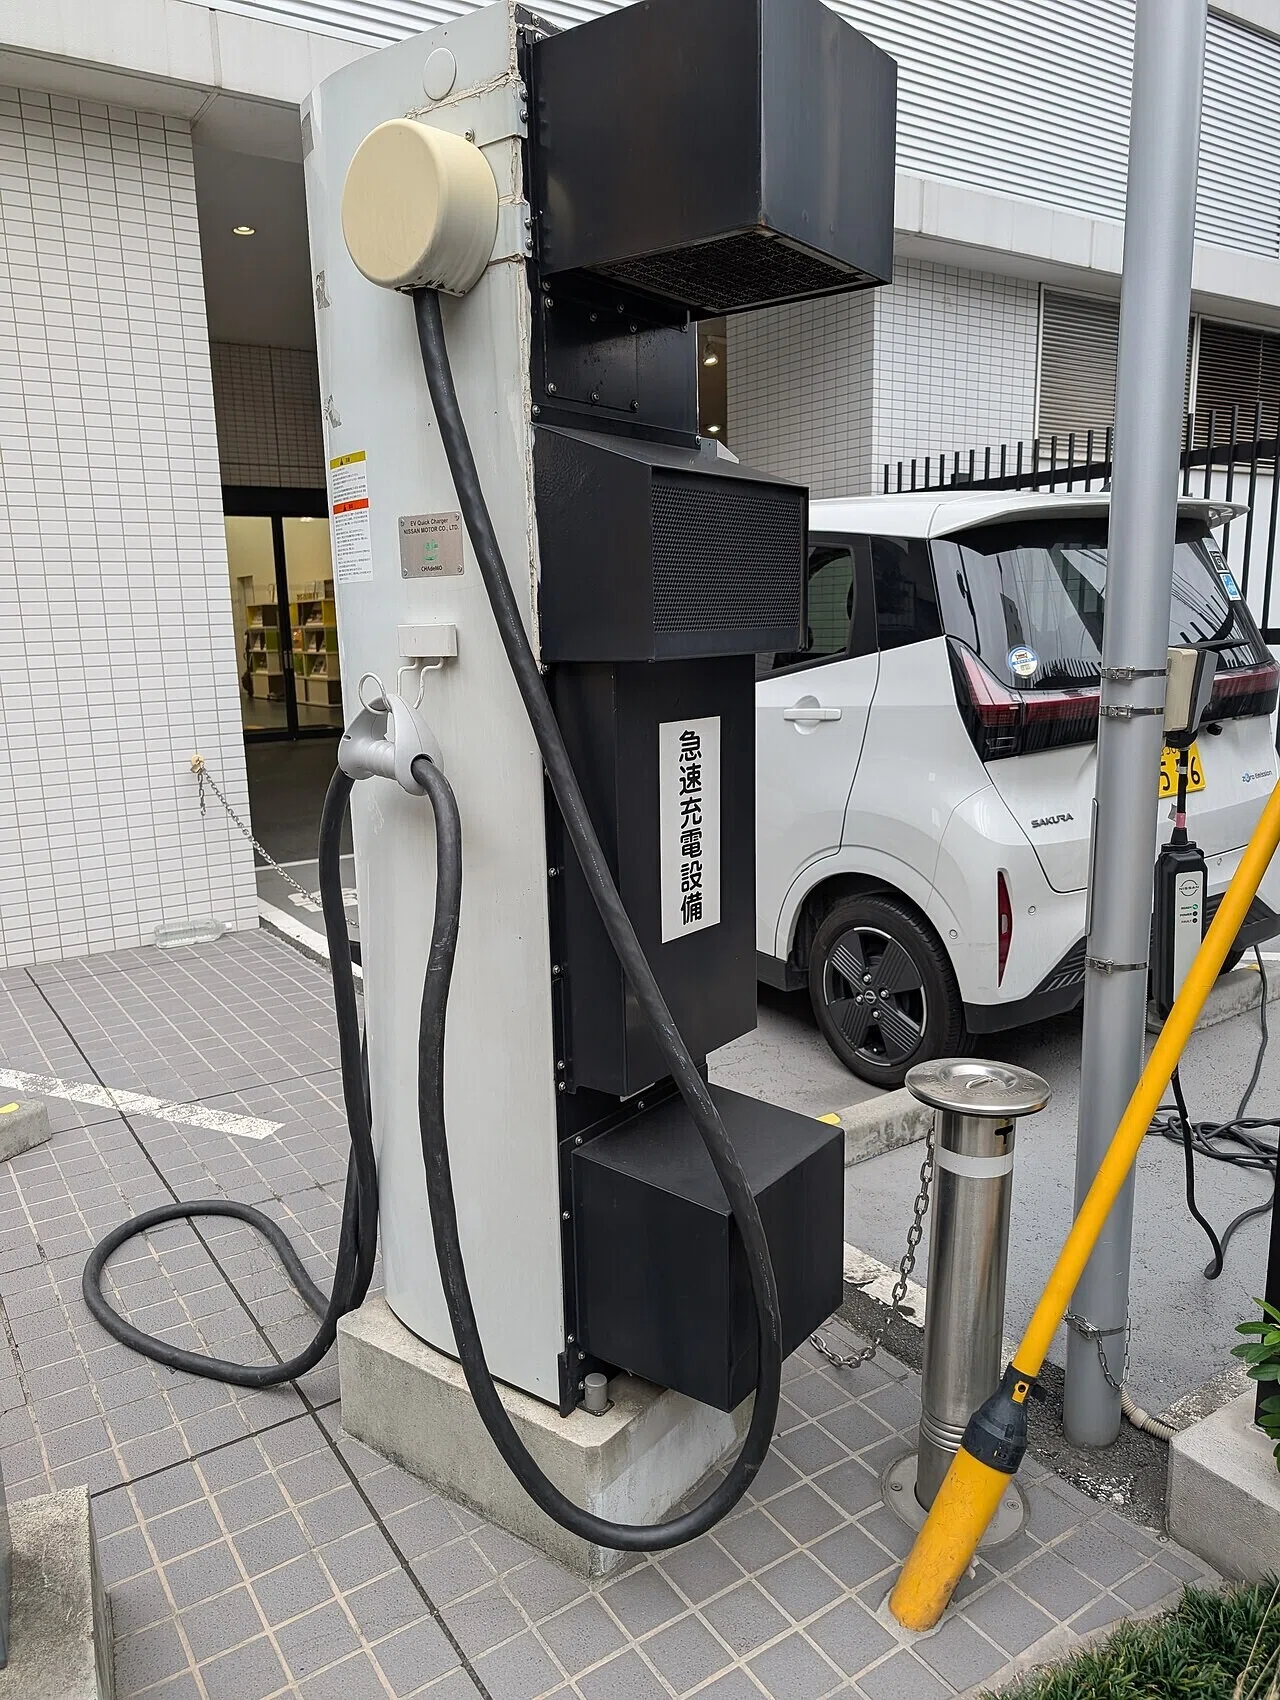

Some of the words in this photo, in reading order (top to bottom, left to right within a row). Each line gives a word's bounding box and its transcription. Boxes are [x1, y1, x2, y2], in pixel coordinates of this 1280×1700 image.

[678, 729, 703, 926] 急速充電設備
[1031, 812, 1074, 829] SAKURA
